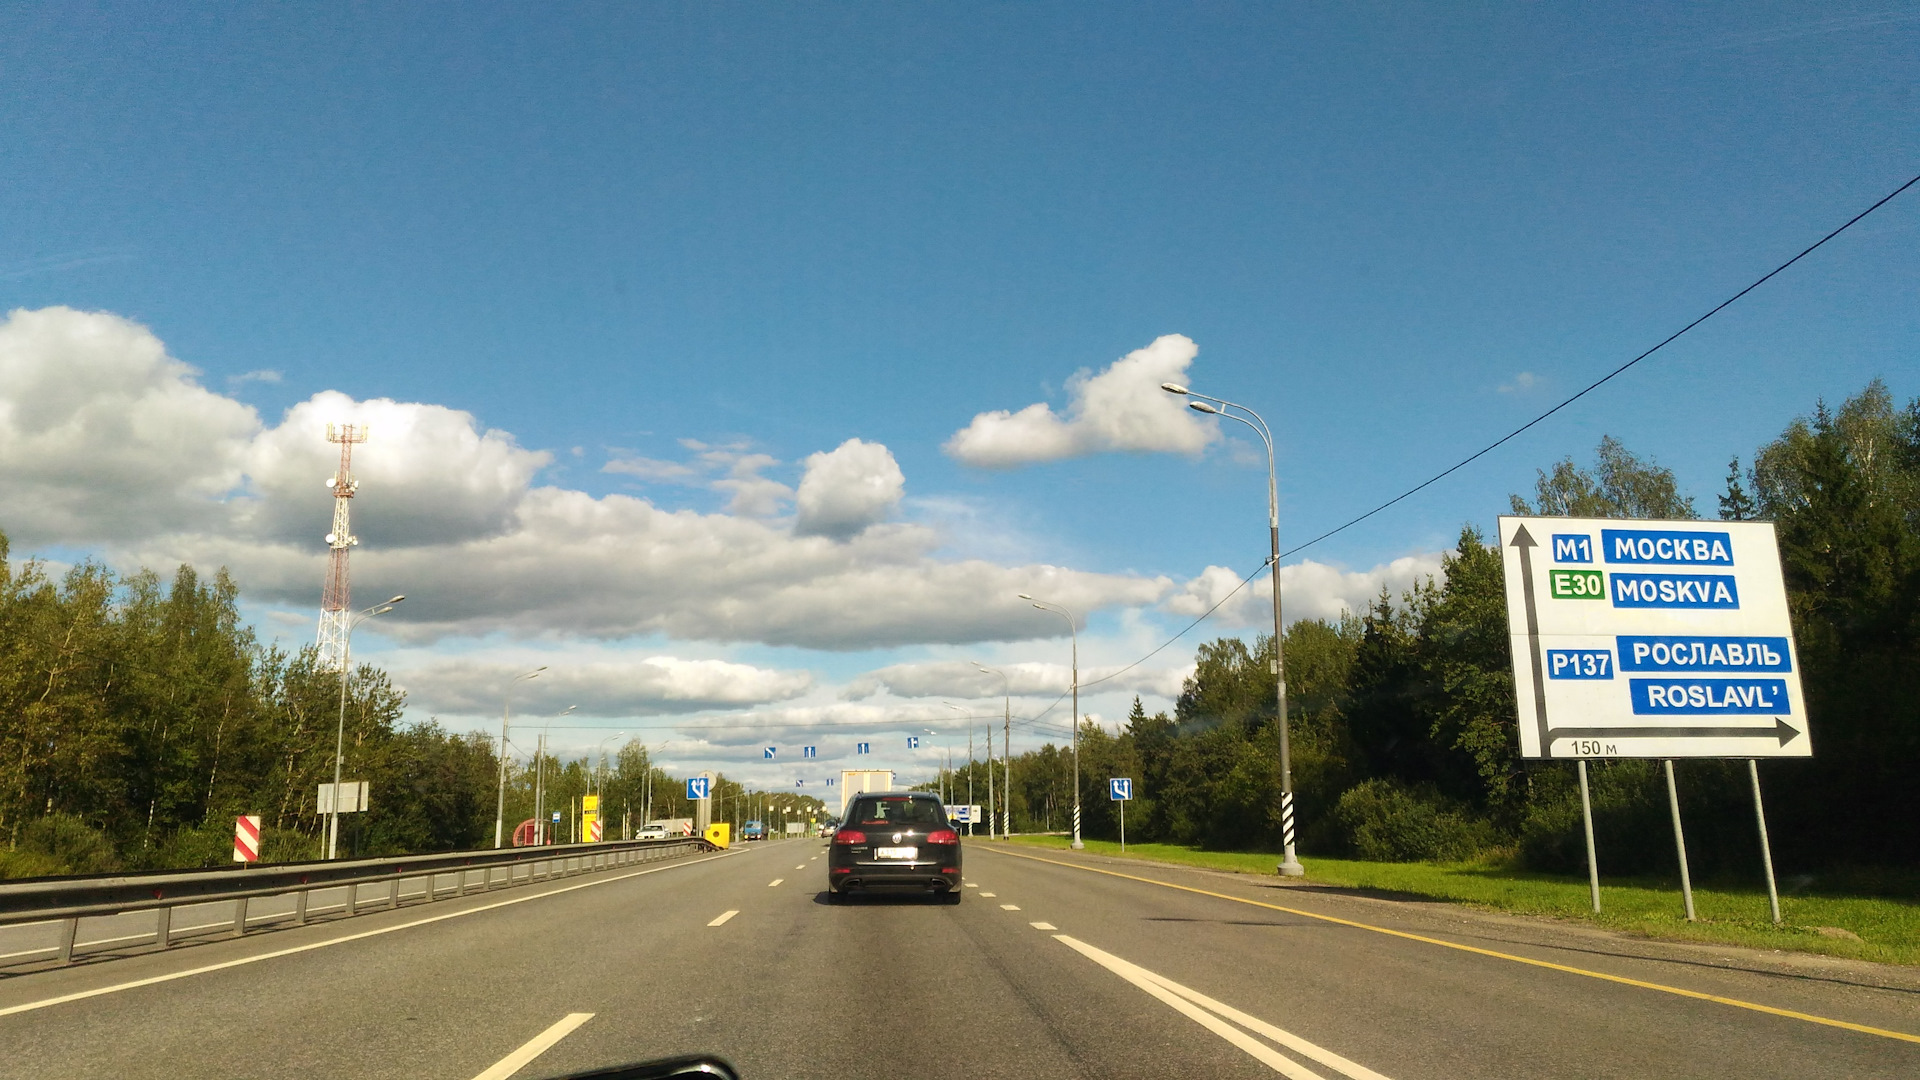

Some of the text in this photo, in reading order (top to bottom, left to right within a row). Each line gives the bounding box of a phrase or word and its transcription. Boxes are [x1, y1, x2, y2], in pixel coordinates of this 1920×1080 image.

[1556, 538, 1592, 561] М1
[1615, 538, 1730, 561] МОСКВА
[1554, 573, 1601, 595] E30
[1616, 580, 1733, 603] MOSKVA
[1552, 654, 1610, 676] Р137
[1633, 643, 1781, 666] РОСЛАВЛЬ
[1571, 740, 1601, 755] 150
